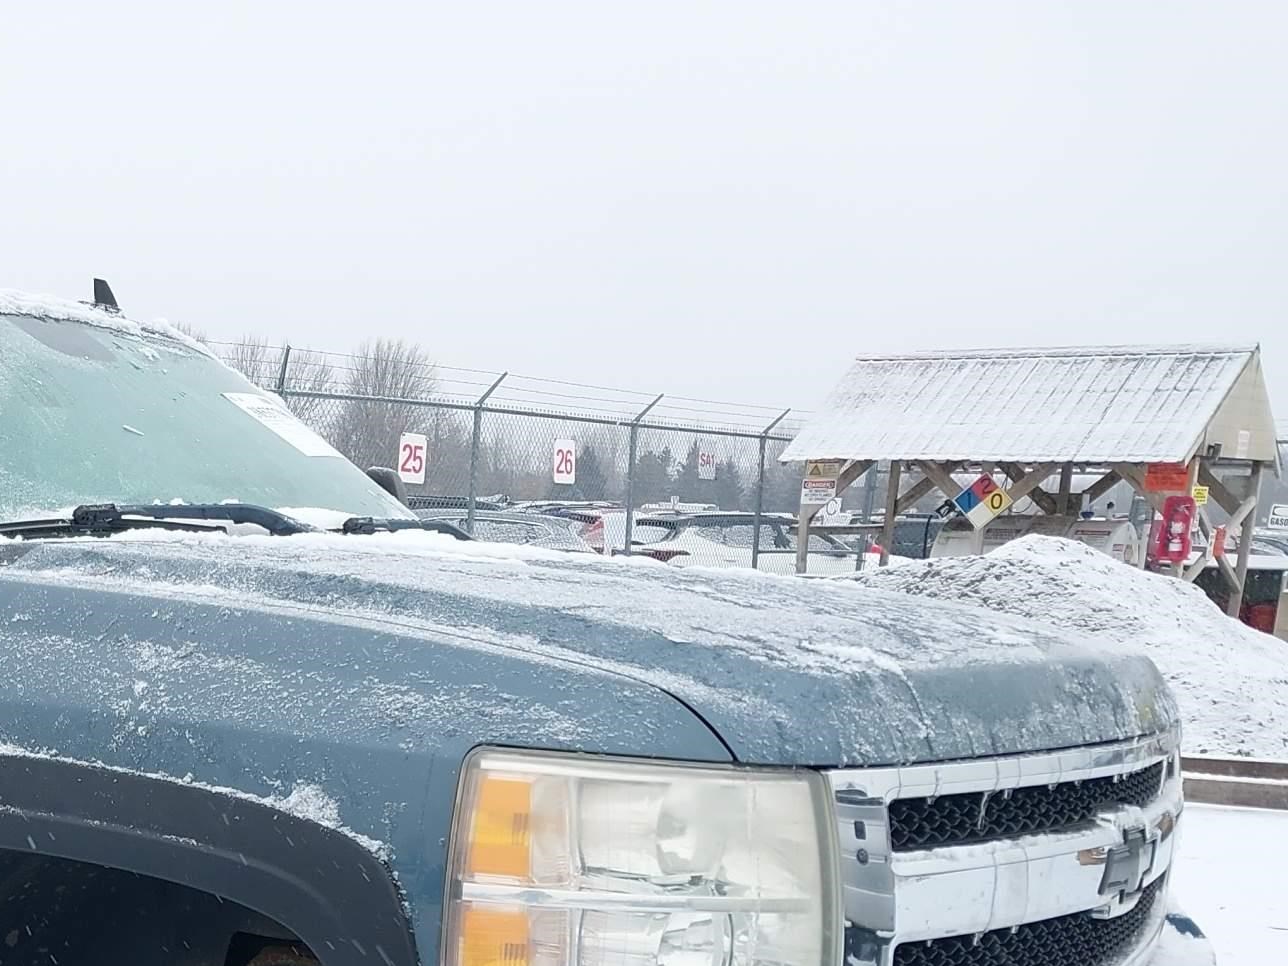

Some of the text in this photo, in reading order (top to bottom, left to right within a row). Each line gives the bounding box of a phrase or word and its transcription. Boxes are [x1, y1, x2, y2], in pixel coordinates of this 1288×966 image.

[400, 443, 424, 474] 25
[555, 448, 573, 475] 26
[980, 478, 993, 495] 2
[966, 492, 972, 509] 1
[990, 492, 1003, 510] 0
